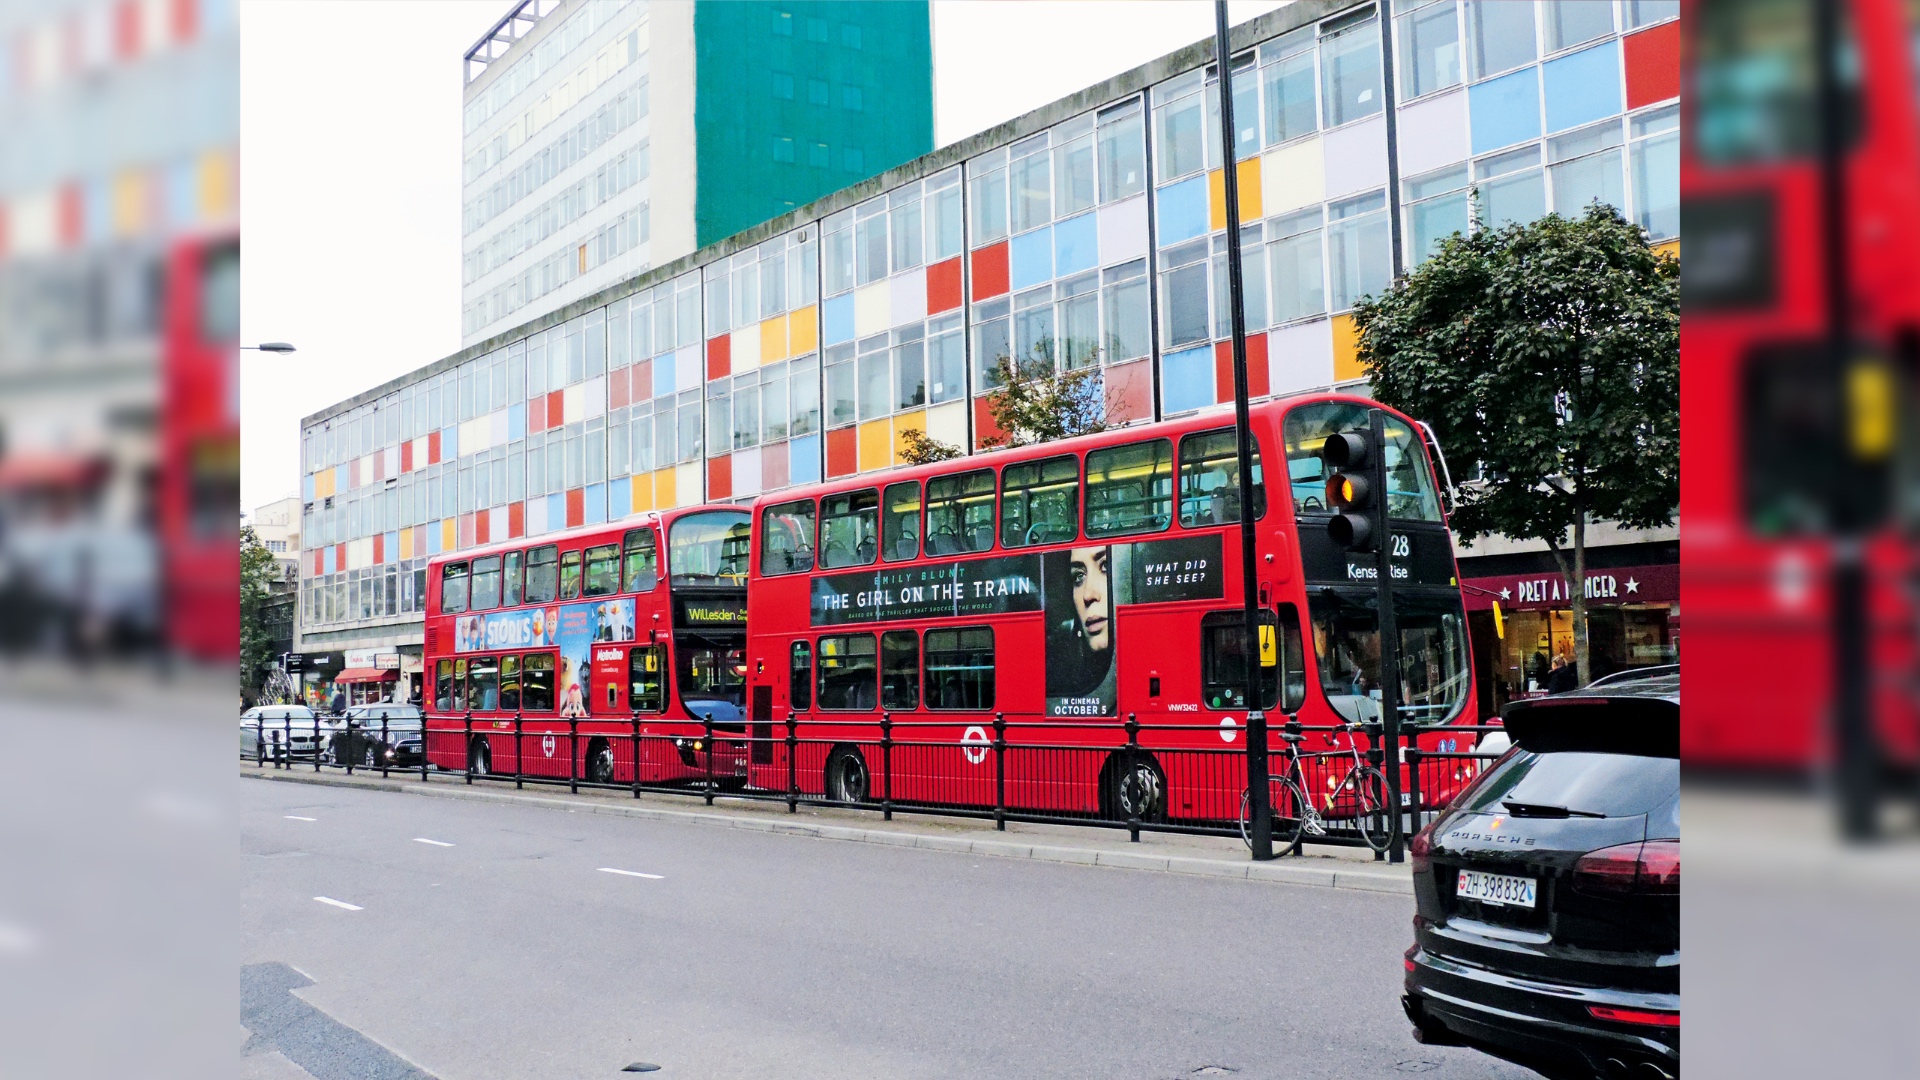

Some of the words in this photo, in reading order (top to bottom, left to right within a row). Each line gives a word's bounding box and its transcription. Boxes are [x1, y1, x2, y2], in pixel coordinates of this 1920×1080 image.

[1391, 534, 1409, 556] 28
[1145, 561, 1179, 574] WHAT
[1185, 559, 1207, 570] DID
[1347, 563, 1378, 579] Kensa
[874, 574, 912, 586] EMILY
[921, 568, 965, 581] BLUNT
[1146, 574, 1170, 586] SHE
[1176, 572, 1205, 584] SEE?
[822, 593, 849, 611] THE
[857, 589, 893, 608] GIRL
[901, 586, 923, 604] ON
[932, 582, 964, 600] THE
[973, 576, 1030, 598] TRAIN
[1518, 579, 1548, 602] PRET
[1552, 578, 1561, 600] A
[688, 608, 735, 620] Willesden
[887, 608, 912, 616] THRILLER
[487, 617, 531, 645] STORKS
[596, 647, 624, 661] Metroline
[1071, 697, 1100, 705] CINEMAS
[1054, 705, 1098, 715] OCTOBER
[1101, 704, 1107, 715] 5
[1451, 831, 1536, 846] PORSCHE
